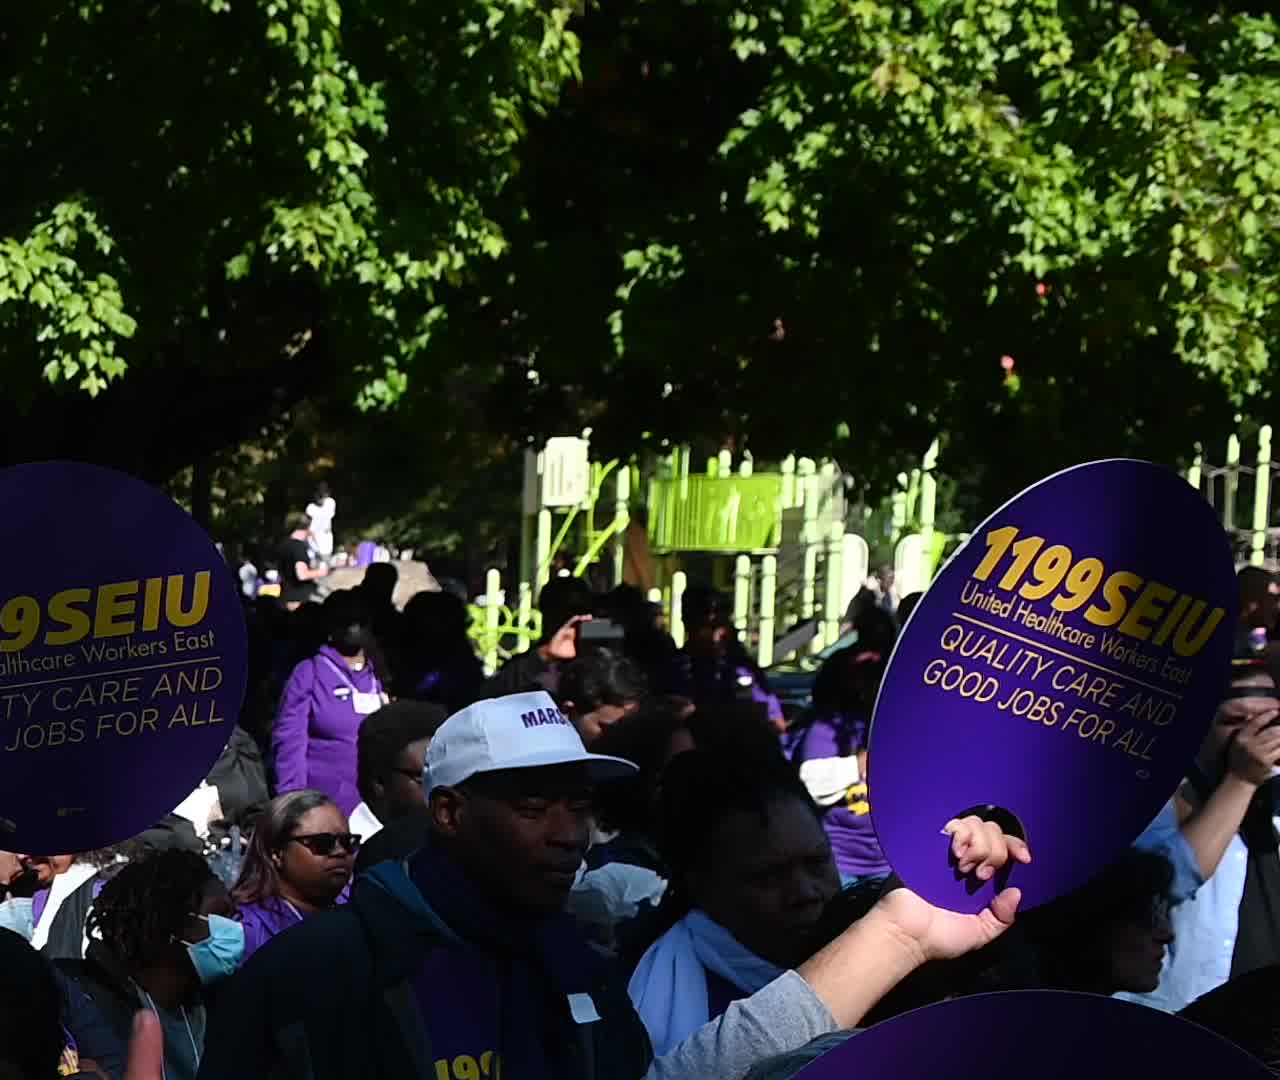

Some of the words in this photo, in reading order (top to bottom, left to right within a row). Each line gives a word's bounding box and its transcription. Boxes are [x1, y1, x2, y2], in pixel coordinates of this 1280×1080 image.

[972, 526, 1225, 657] 1199SEIU
[80, 635, 168, 665] Workers
[174, 629, 216, 654] East
[960, 583, 1013, 620] United
[1015, 604, 1096, 649] Healthcare
[1100, 631, 1160, 671] Workers
[1160, 657, 1193, 684] East
[52, 678, 141, 712] CARE
[151, 667, 223, 697] AND
[924, 659, 998, 703] GOOD
[997, 689, 1064, 727] JOBS
[1063, 712, 1116, 746] FOR
[1112, 729, 1158, 761] ALL
[940, 624, 1048, 681] QUALITY
[1052, 665, 1124, 708] CARE
[1120, 693, 1177, 727] AND
[5, 717, 86, 753] JOBS
[96, 706, 160, 738] FOR
[168, 699, 225, 729] ALL
[521, 707, 568, 728] MARS
